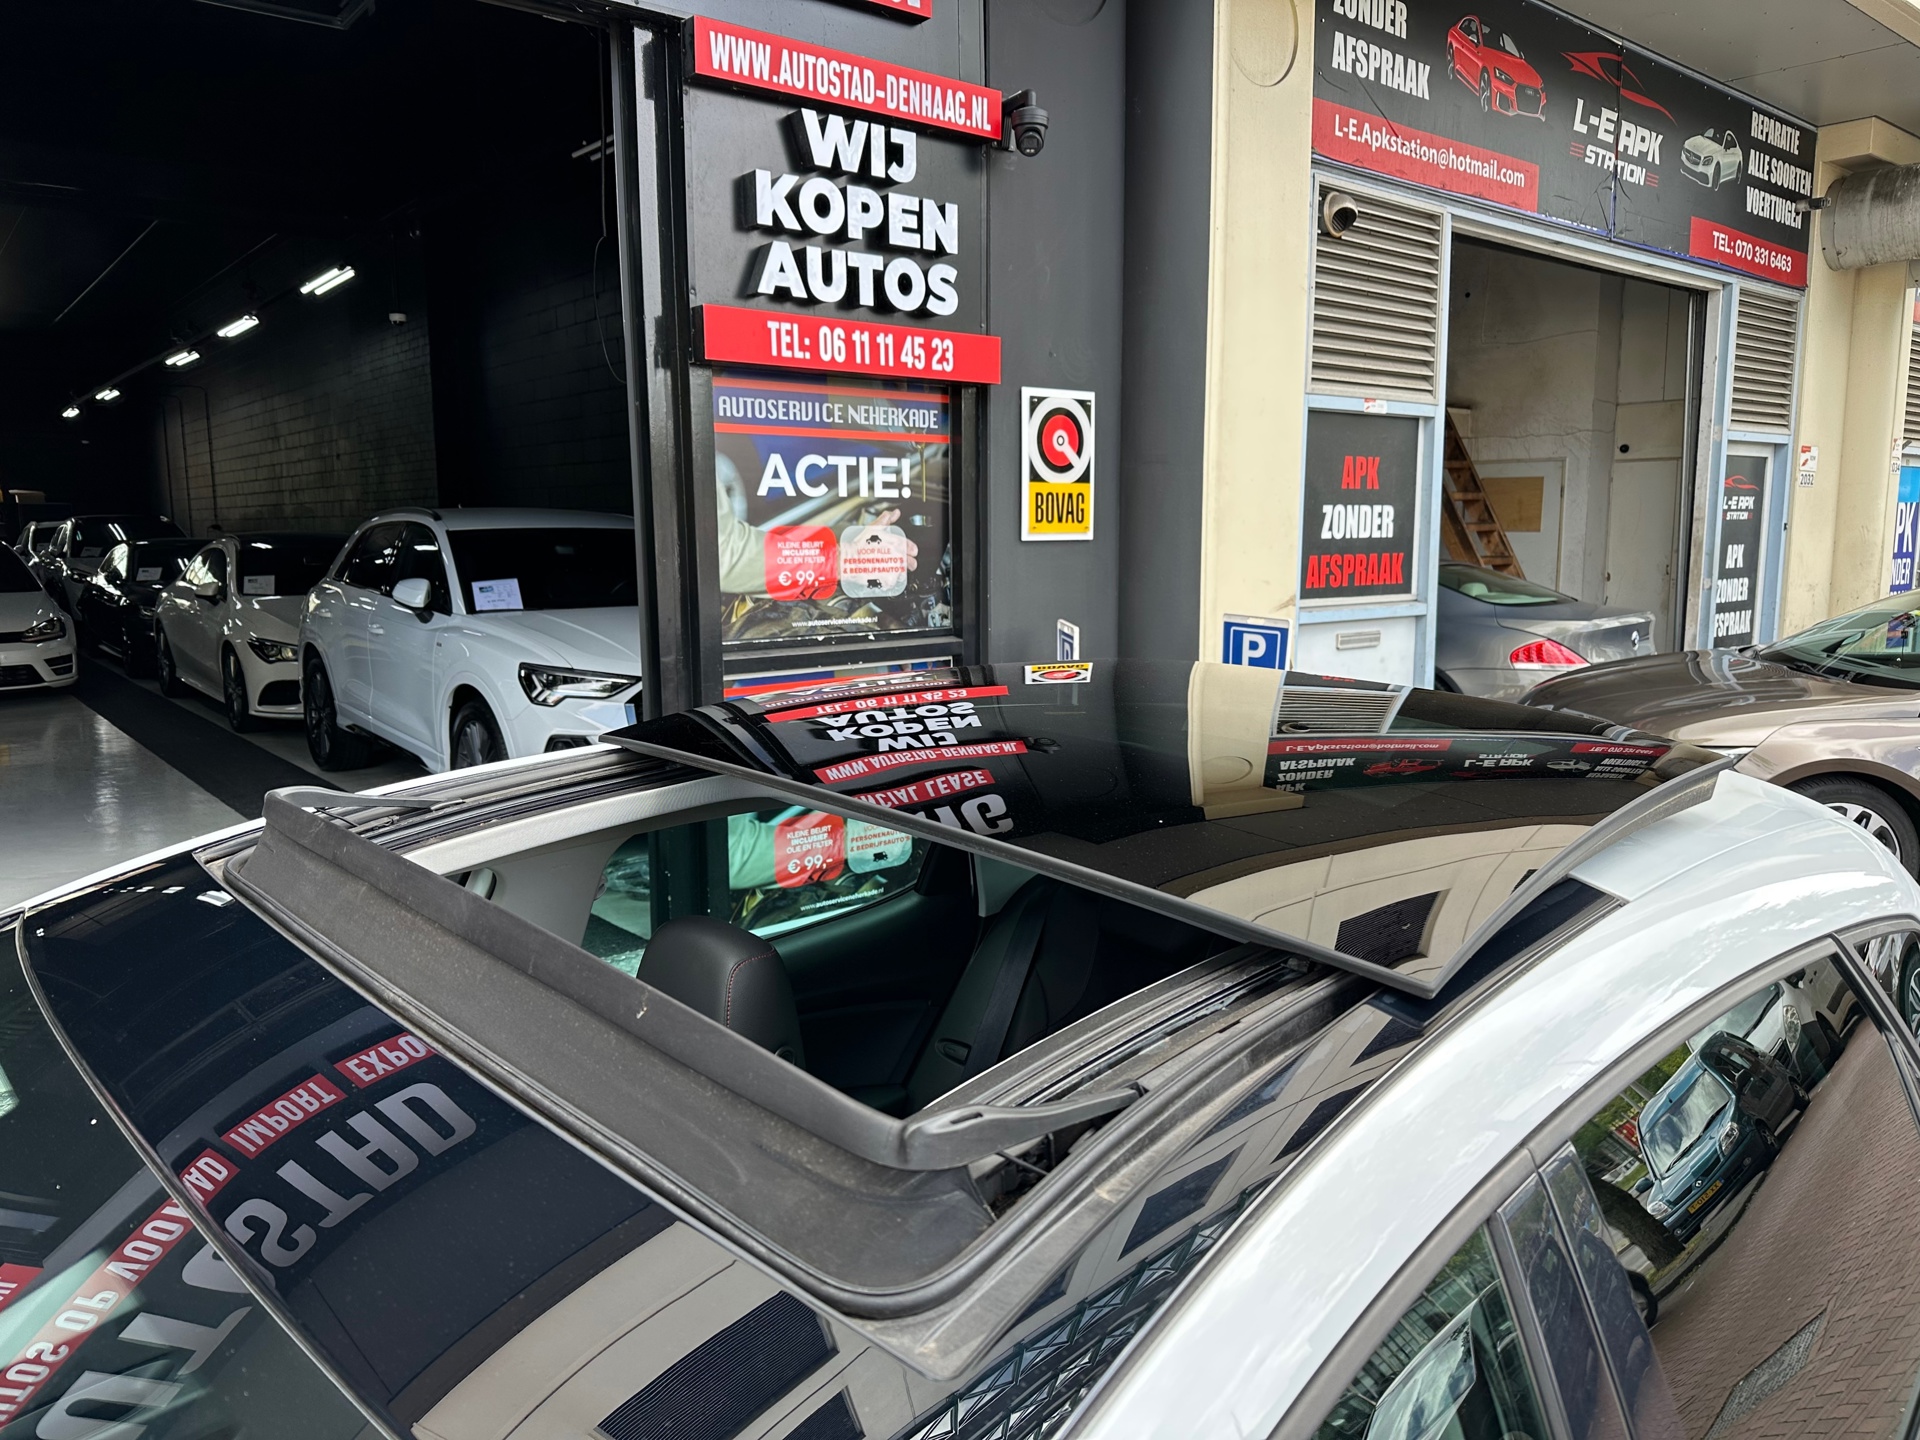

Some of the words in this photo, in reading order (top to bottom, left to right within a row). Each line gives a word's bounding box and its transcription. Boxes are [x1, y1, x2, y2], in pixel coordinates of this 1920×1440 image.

[709, 30, 991, 131] WWW.AUTOSTAD-DENHAAG.NL
[1331, 31, 1430, 100] AFSPRAAK
[801, 107, 917, 183] WIJ
[1573, 97, 1618, 143] L-E
[1618, 120, 1663, 165] APK
[1751, 110, 1800, 155] REPARATIE
[1334, 113, 1525, 187] L-E.Apkstation@hotmail.com
[1584, 144, 1646, 186] STATION
[1748, 149, 1770, 181] ALLE
[1770, 158, 1812, 196] SOORTEN
[755, 168, 958, 254] KOPEN
[1713, 231, 1733, 254] TEL:
[1735, 239, 1752, 260] 070
[1755, 246, 1769, 266] 331
[1770, 252, 1792, 272] 6463
[757, 240, 958, 316] AUTOS
[767, 320, 811, 359] TEL:
[819, 326, 846, 363] 06
[851, 330, 870, 365] 11
[876, 332, 894, 366] 11
[900, 335, 926, 369] 45
[931, 338, 954, 372] 23
[718, 395, 843, 423] AUTOSERVICE
[848, 404, 939, 429] NEHERKADE
[756, 453, 912, 499] ACTIE!
[1341, 455, 1380, 490] APK
[1800, 474, 1814, 485] 2032
[1035, 492, 1085, 524] BOVAG
[1723, 496, 1738, 509] L-E
[1738, 496, 1755, 509] APK
[1321, 504, 1394, 540] ZONDER
[804, 556, 825, 564] FILTER
[844, 557, 904, 565] PERSONENAUTO'S
[1305, 552, 1404, 589] AFSPRAAK
[1726, 544, 1745, 569] APK
[778, 571, 792, 586] €
[1716, 577, 1749, 603] ZONDER
[1242, 632, 1266, 666] P
[787, 829, 810, 839] KLEINE
[810, 825, 832, 835] BEURT
[791, 833, 828, 846] INCLUSIEF
[788, 859, 801, 874] €
